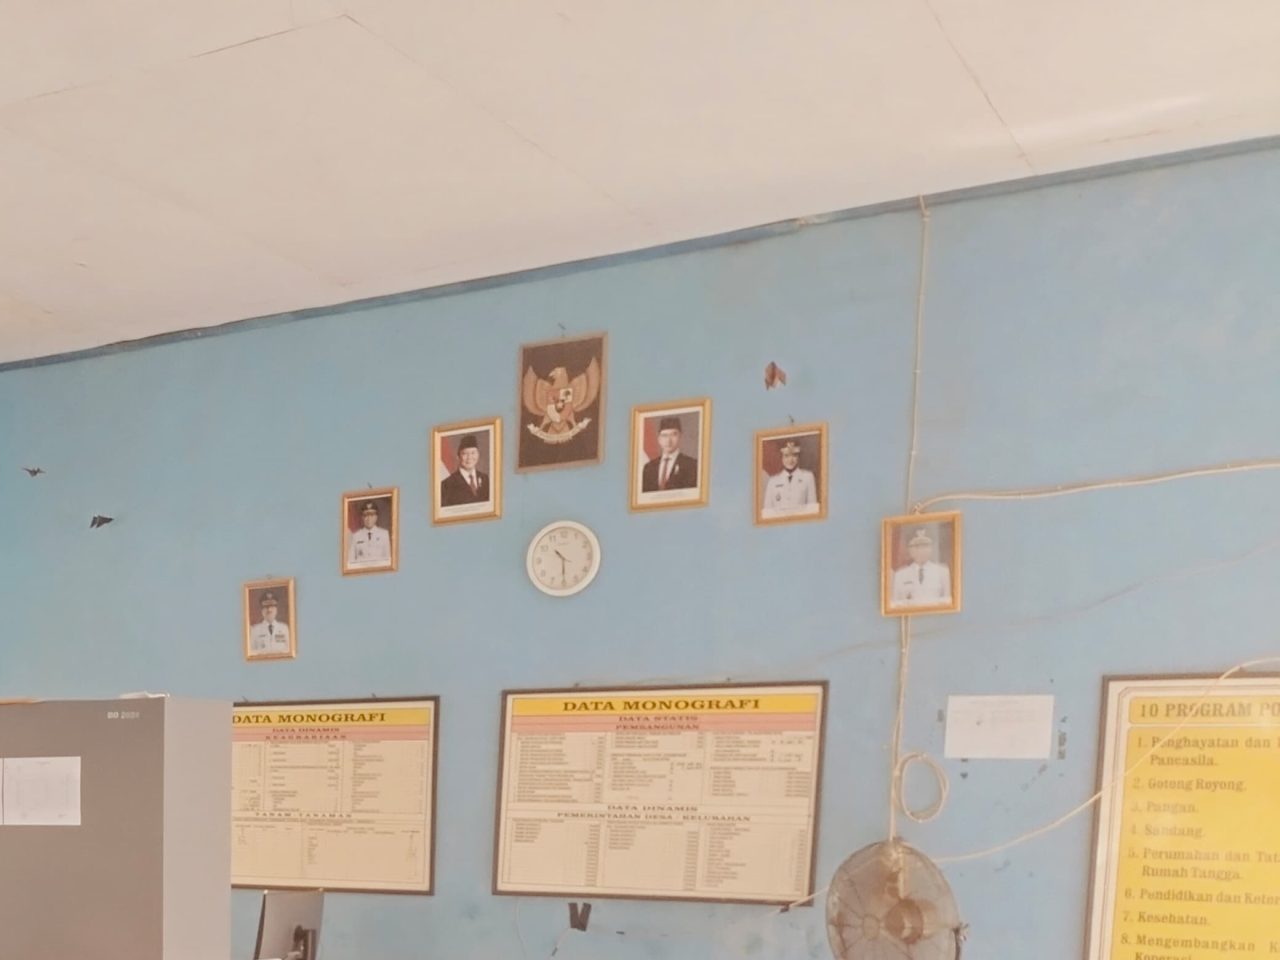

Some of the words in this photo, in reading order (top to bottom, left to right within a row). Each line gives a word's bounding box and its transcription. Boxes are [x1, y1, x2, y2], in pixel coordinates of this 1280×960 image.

[563, 701, 615, 711] DATA
[623, 699, 760, 711] MONOGRAFI
[1141, 703, 1159, 718] 10
[1165, 702, 1252, 718] PROGRAM
[232, 714, 272, 724] DATA
[278, 712, 386, 723] MONOGRAFI
[1245, 737, 1270, 748] dan
[1148, 778, 1193, 791] Gotong
[1195, 779, 1247, 792] Royong.
[1143, 848, 1219, 861] Perumahan
[1225, 851, 1250, 861] dan
[1257, 851, 1280, 863] Tat
[1142, 865, 1189, 878] Rumah
[1140, 888, 1213, 902] Pendidikan
[1217, 891, 1241, 904] dan
[1136, 934, 1255, 952] Mengembangkan
